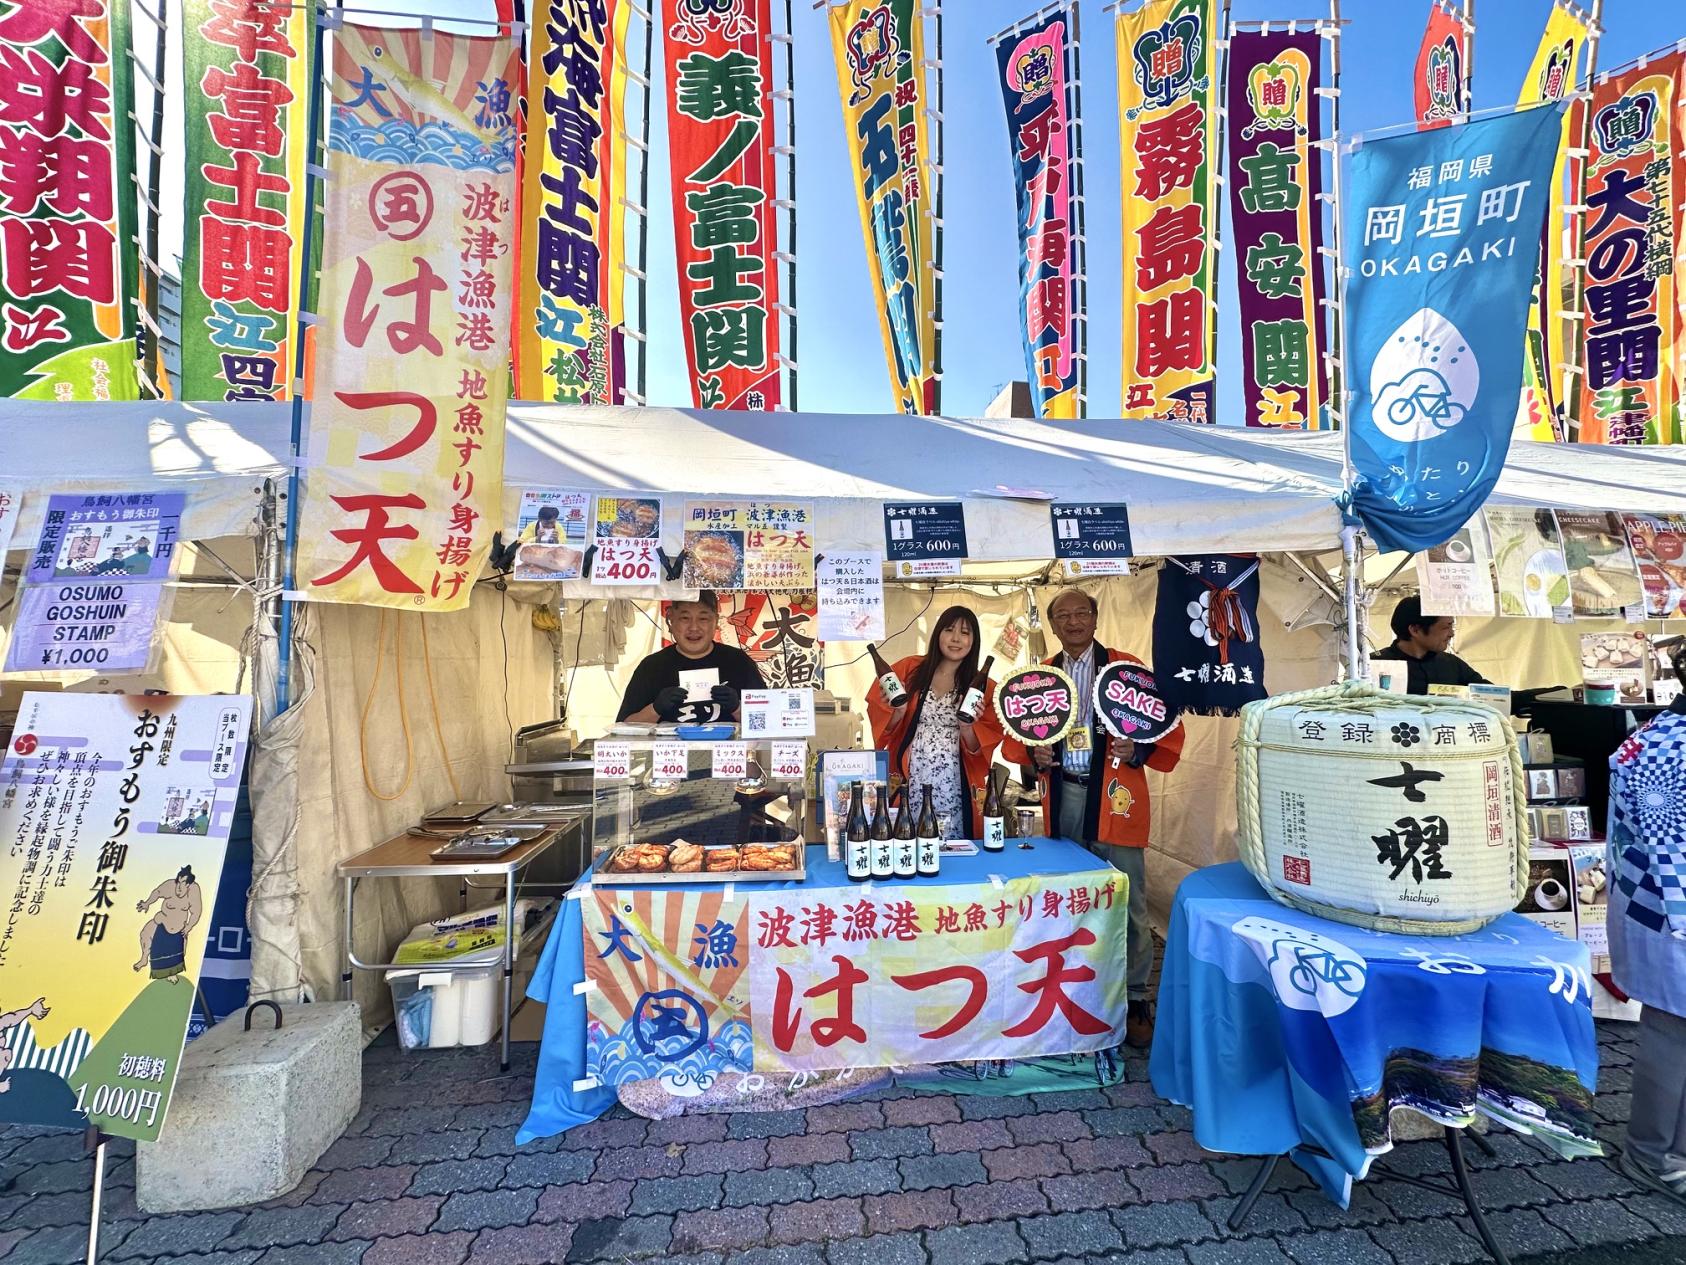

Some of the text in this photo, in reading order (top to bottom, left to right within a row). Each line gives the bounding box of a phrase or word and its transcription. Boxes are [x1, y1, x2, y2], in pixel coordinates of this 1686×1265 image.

[347, 66, 512, 129] 大 漁
[1407, 153, 1494, 192] 福岡県
[1363, 180, 1532, 247] 岡垣町
[1361, 236, 1516, 279] OKAGAKI
[431, 183, 501, 600] 波津漁港 地魚すり身揚げ
[311, 256, 448, 594] はつ天
[69, 507, 160, 522] おすもう御朱印
[692, 507, 806, 523] 岡垣町 波津漁港
[1627, 521, 1667, 533] APPLE
[33, 510, 66, 570] 限定販売
[601, 547, 654, 562] はつ天
[747, 530, 812, 549] はつ天
[827, 557, 872, 567] このブースで
[834, 567, 865, 576] 購入した
[46, 603, 127, 621] GOSHUIN
[58, 585, 124, 602] OSUMO
[52, 625, 116, 642] STAMP
[41, 648, 109, 666] ¥1,000
[1005, 689, 1069, 717] はつ天
[1106, 680, 1167, 722] SAKE
[157, 713, 177, 767] 九州限定
[1298, 720, 1492, 746] 登録 商標
[76, 709, 161, 946] おすもう御朱印
[1366, 760, 1453, 885] 七曜
[756, 882, 1115, 949] 波津漁港 地魚すり身揚げ
[597, 914, 739, 969] 大 漁
[772, 927, 1116, 1052] はつ天
[117, 1052, 168, 1083] 初穂料
[71, 1081, 163, 1127] 1,000円
